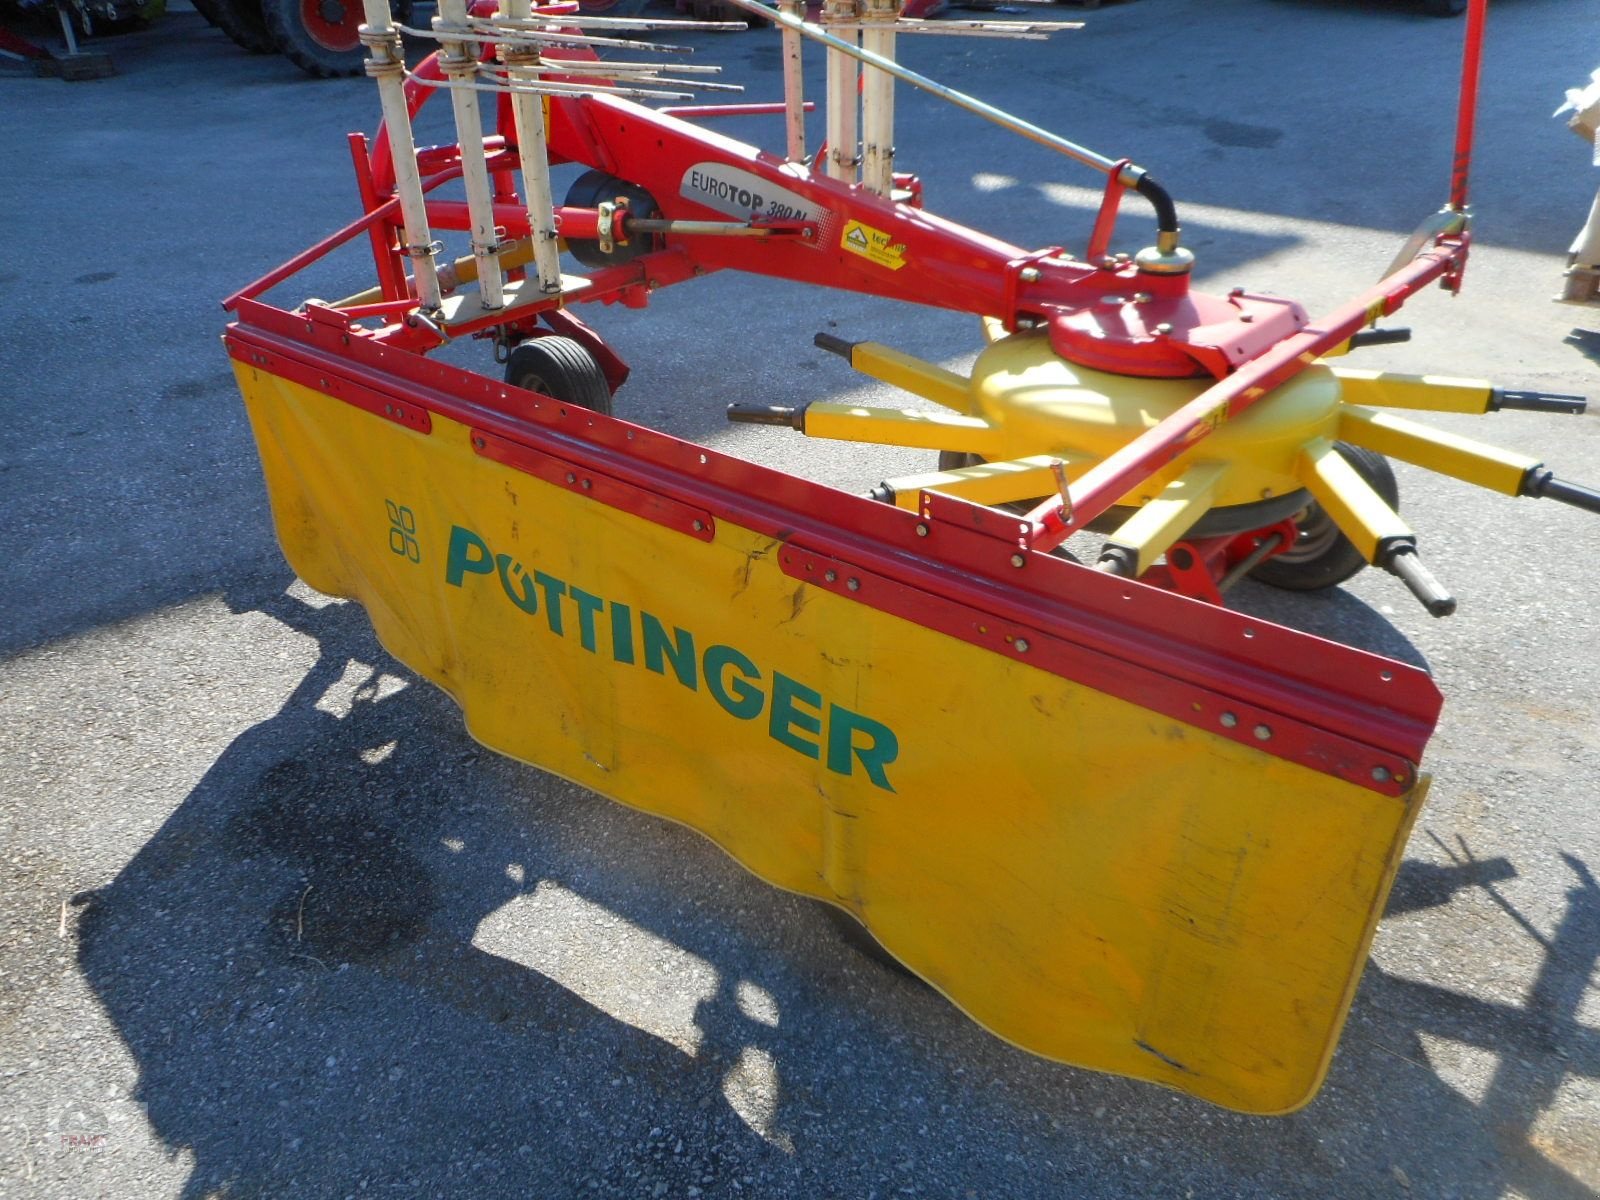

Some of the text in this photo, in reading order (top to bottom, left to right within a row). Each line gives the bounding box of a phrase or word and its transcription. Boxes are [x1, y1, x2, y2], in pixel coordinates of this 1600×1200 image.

[691, 171, 764, 211] EUROTOP
[766, 201, 793, 218] 380
[445, 524, 899, 794] PÖTTINGER
